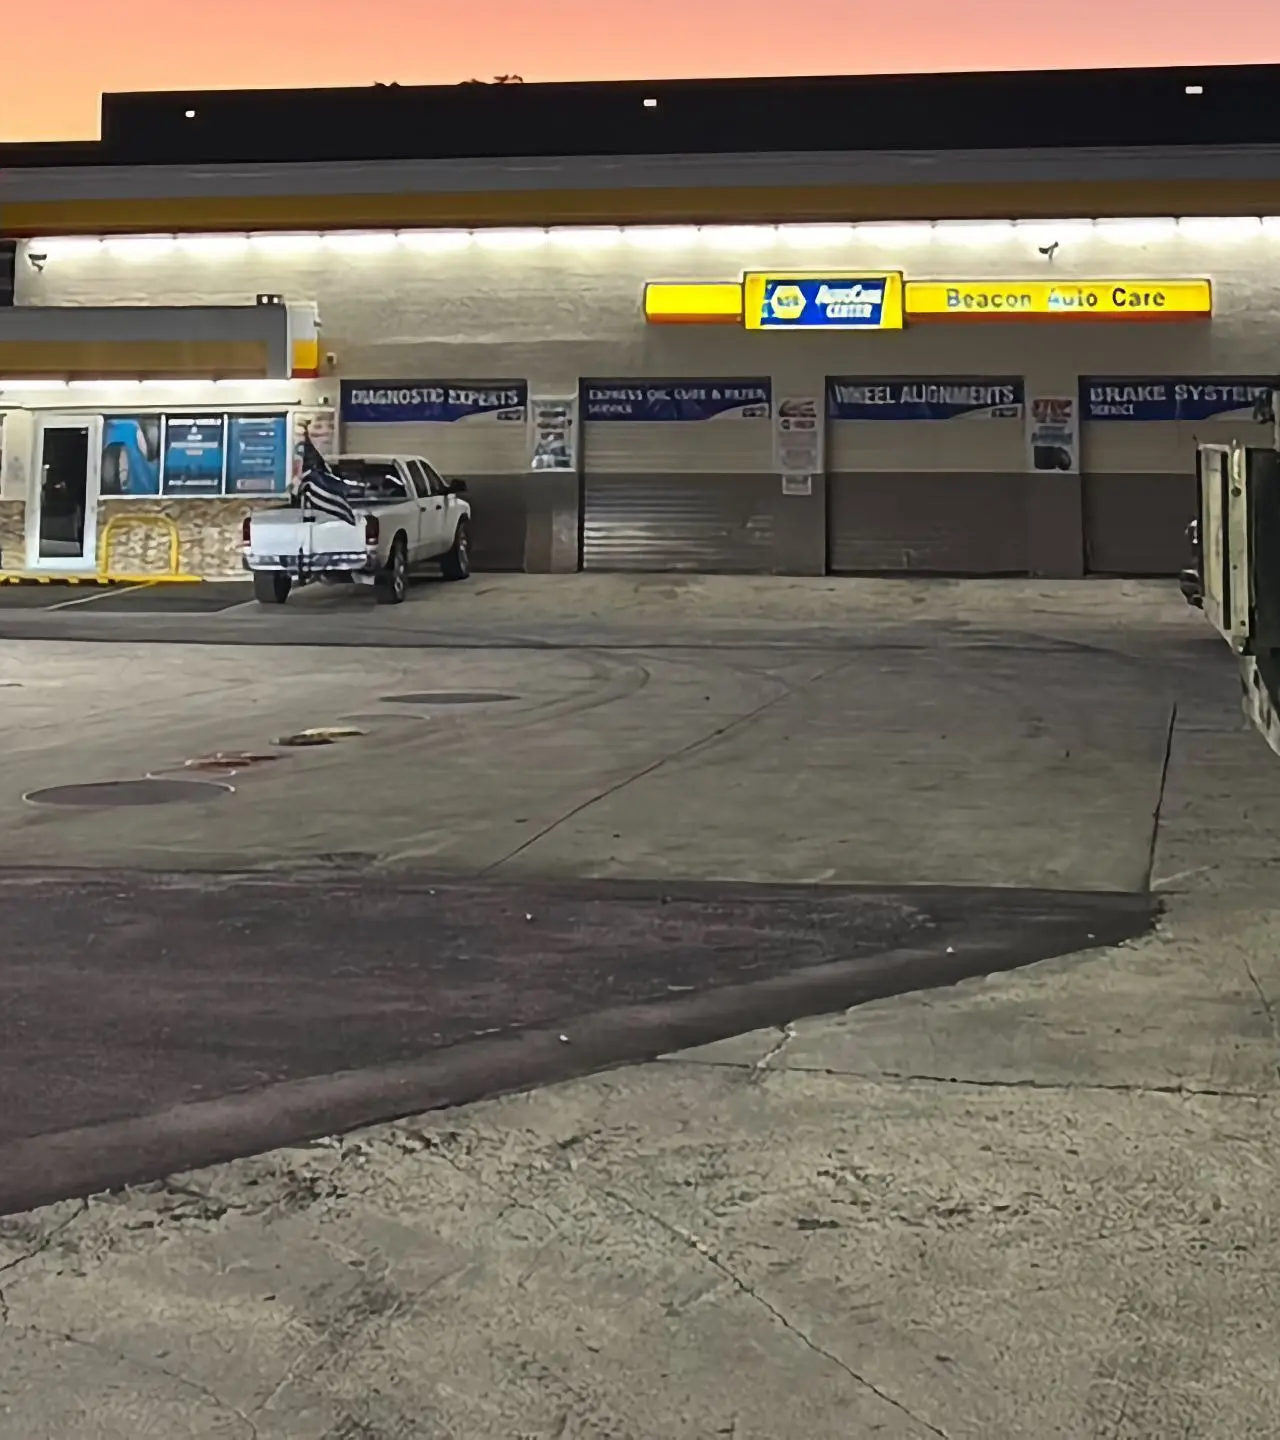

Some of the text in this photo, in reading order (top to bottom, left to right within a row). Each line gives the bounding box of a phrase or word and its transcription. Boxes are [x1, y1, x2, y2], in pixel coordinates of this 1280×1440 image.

[946, 287, 1165, 308] Beacon Auto Care
[351, 388, 518, 406] DIAGNOSTIC EXPERTS
[835, 384, 1014, 405] WHEEL ALIGNMENTS
[1090, 385, 1166, 403] BRAKE
